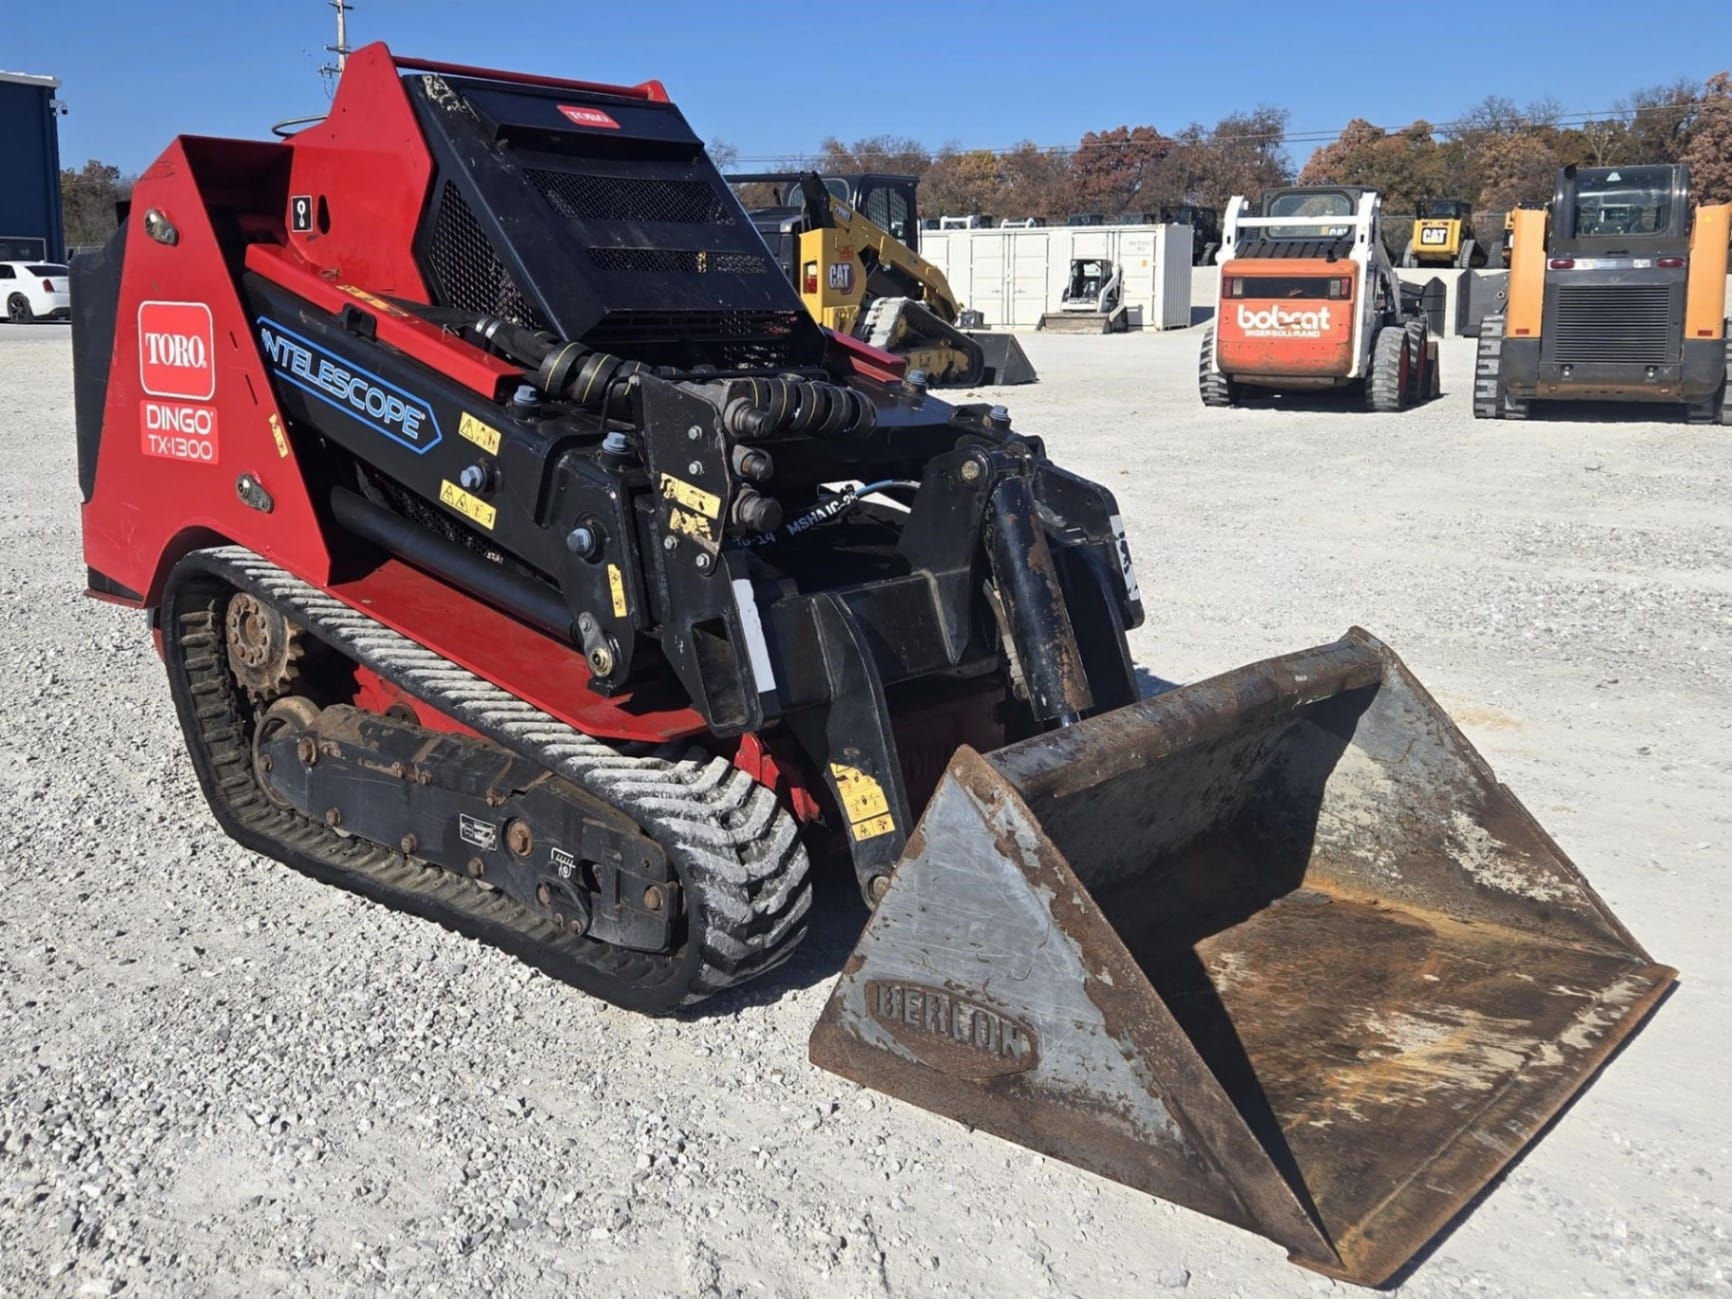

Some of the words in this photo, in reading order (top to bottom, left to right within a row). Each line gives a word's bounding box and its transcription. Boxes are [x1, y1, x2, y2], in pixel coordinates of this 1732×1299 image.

[564, 111, 609, 122] TORO
[1422, 228, 1446, 244] CAT
[829, 264, 850, 287] CAT
[1237, 304, 1330, 330] bobcat
[145, 333, 206, 368] TORO
[146, 404, 212, 435] DINGO
[786, 510, 827, 535] MSHA
[877, 985, 1032, 1060] BERLON
